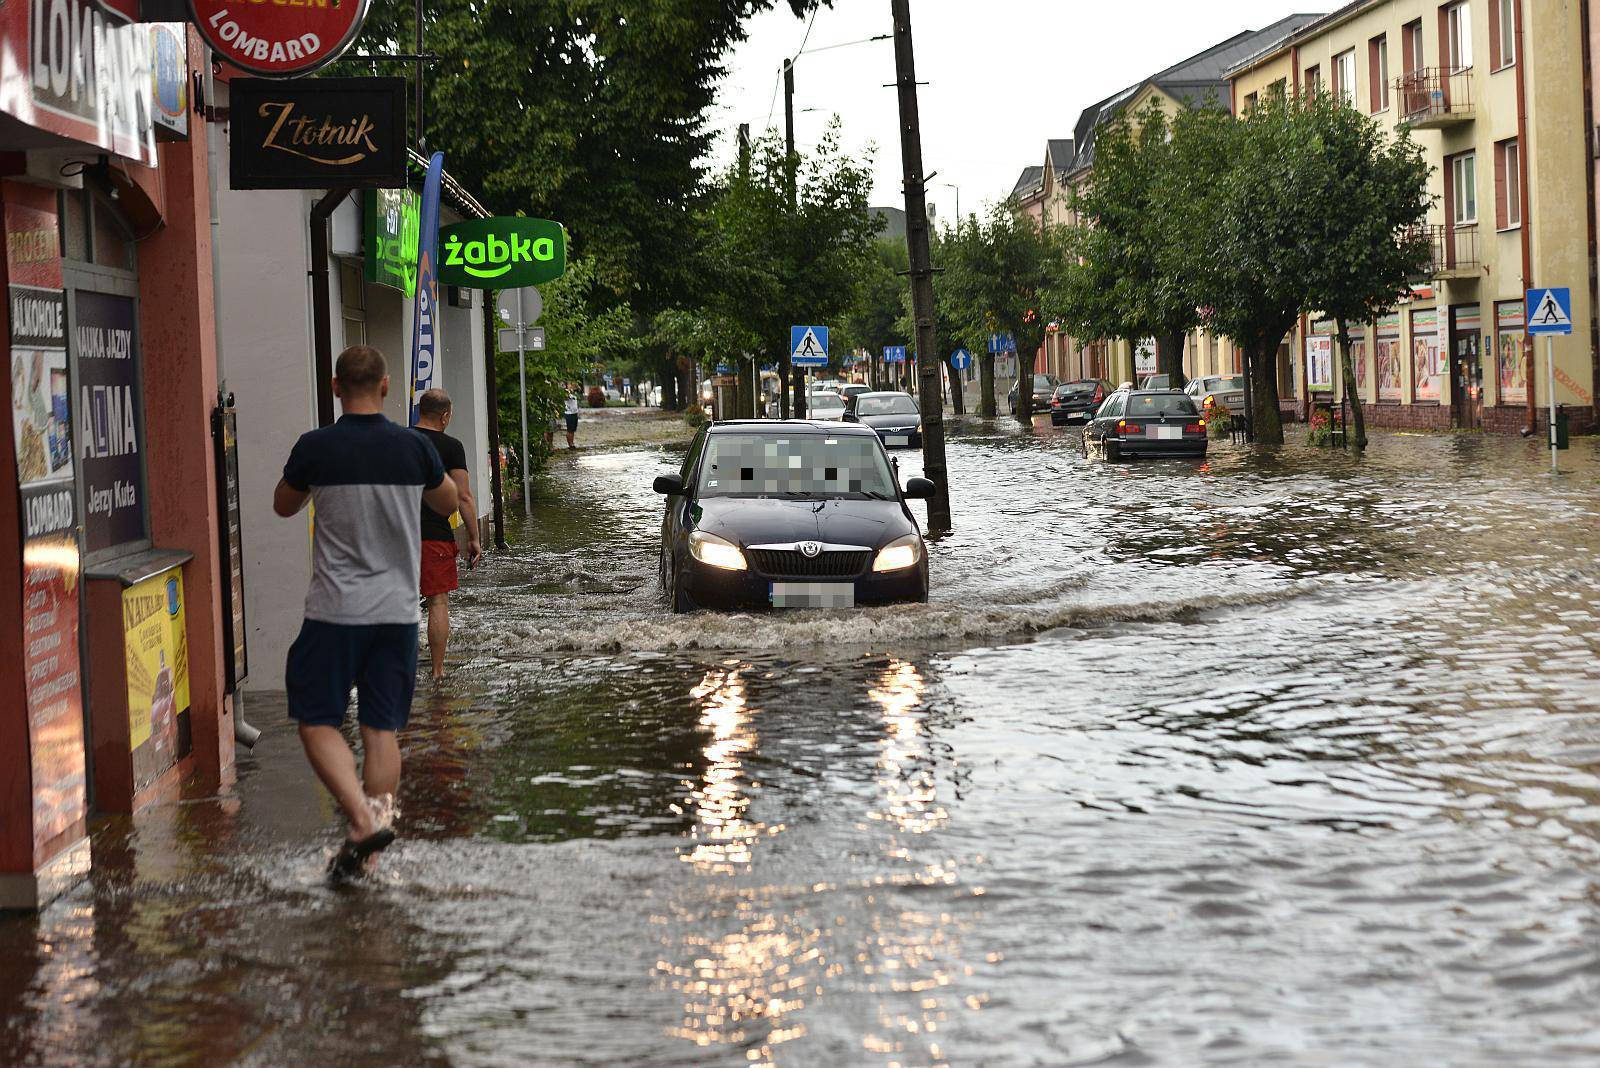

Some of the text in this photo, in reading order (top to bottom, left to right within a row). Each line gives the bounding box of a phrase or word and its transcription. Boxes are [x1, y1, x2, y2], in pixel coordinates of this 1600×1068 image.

[209, 9, 321, 63] LOMBARD
[445, 233, 554, 266] żabka
[13, 299, 64, 340] ALKOHOLE
[76, 326, 132, 360] NAUKA JAZDY
[81, 384, 138, 459] ALMA
[26, 491, 73, 537] LOMBARD
[88, 479, 136, 519] Jerzy Kuta
